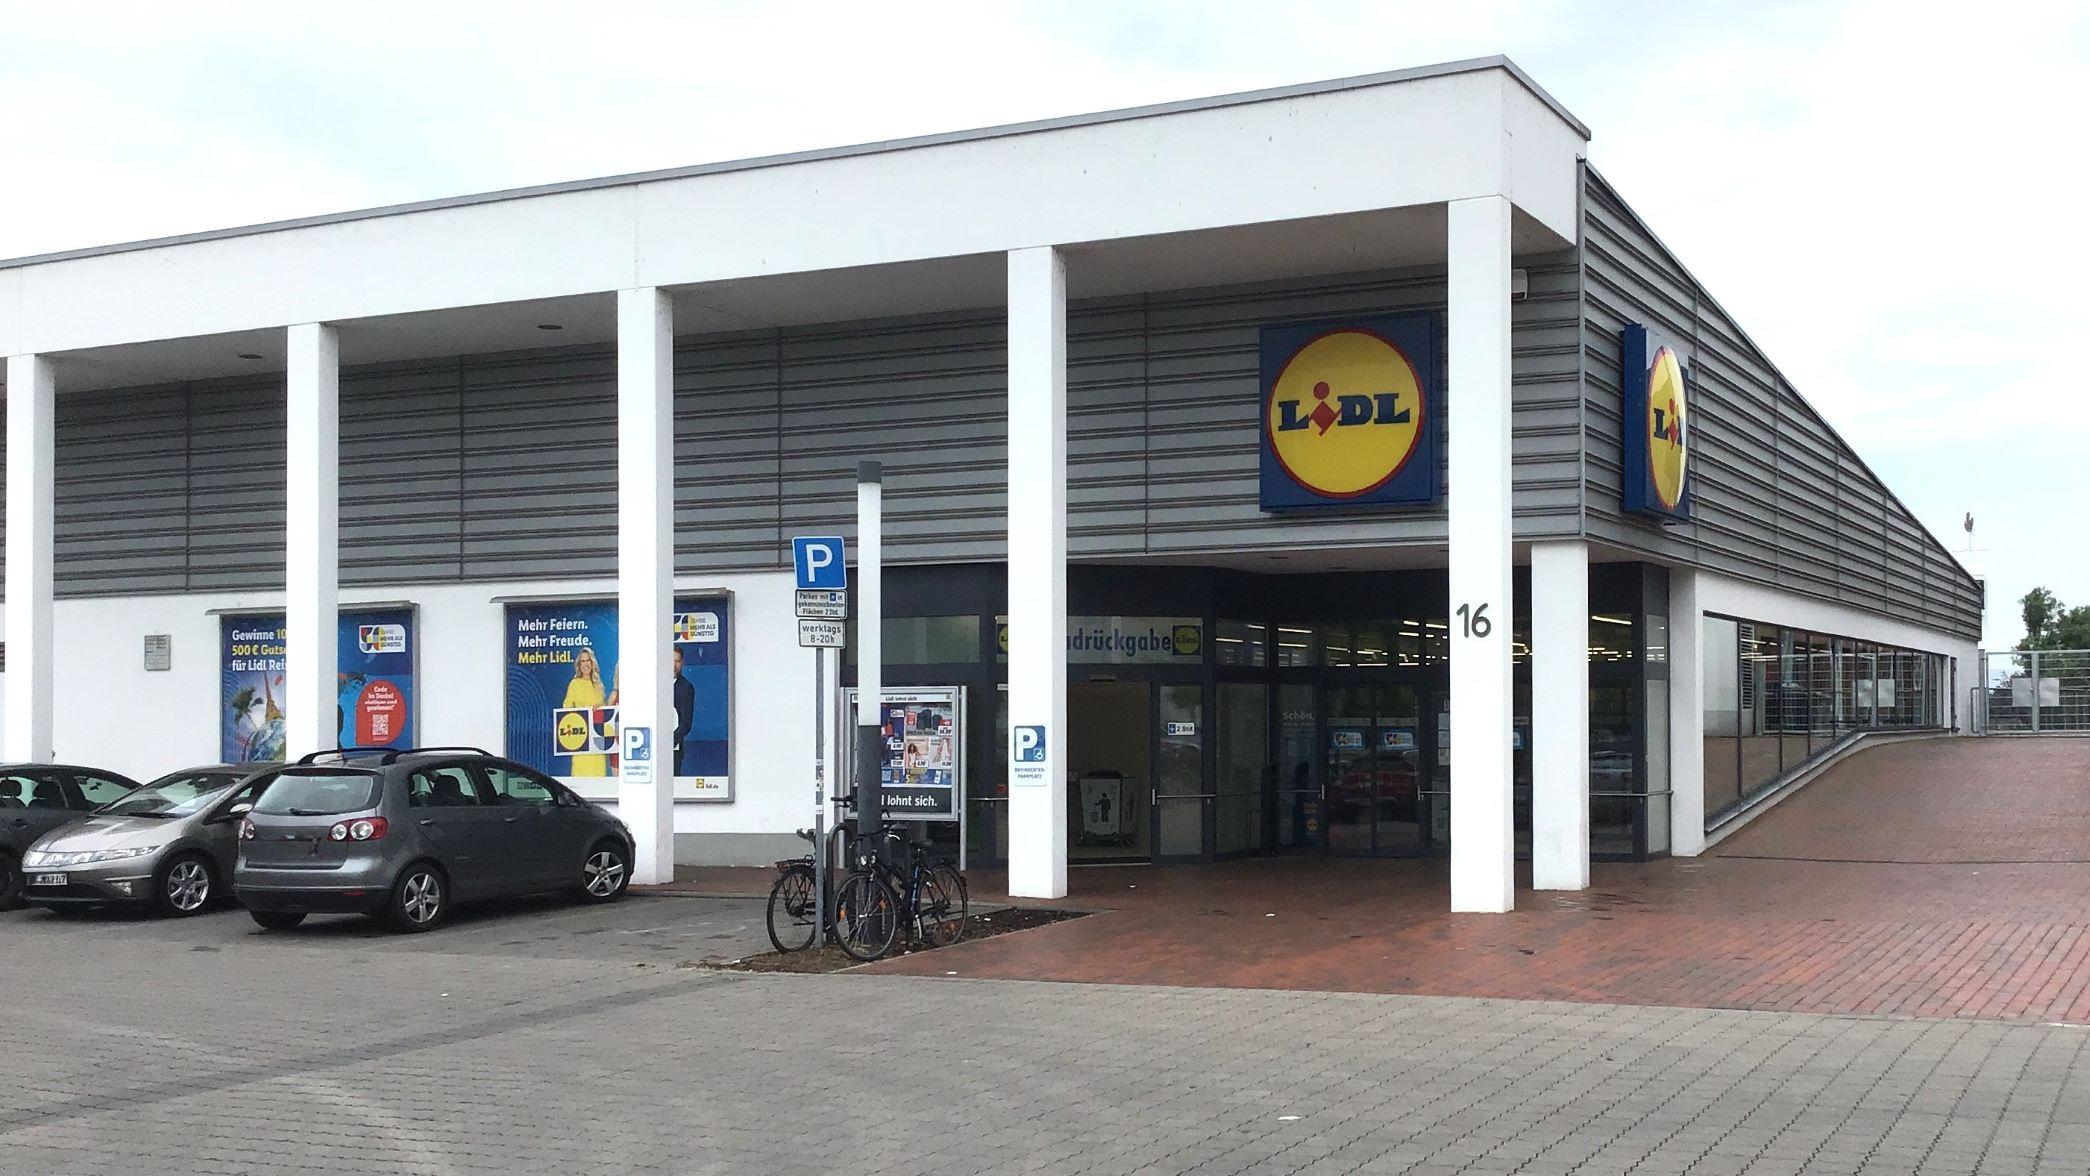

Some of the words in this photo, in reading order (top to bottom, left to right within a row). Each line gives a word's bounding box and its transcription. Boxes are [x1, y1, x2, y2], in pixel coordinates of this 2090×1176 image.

[806, 544, 833, 582] P
[799, 592, 818, 600] Parken
[518, 619, 547, 631] Mehr
[549, 618, 588, 630] Feiern.
[1456, 603, 1491, 638] 16
[232, 629, 274, 640] Gewinne
[518, 635, 547, 648] Mehr
[549, 634, 592, 646] Freude.
[232, 645, 251, 656] 500
[518, 652, 547, 664] Mehr
[549, 651, 574, 663] Lidl.
[232, 660, 246, 671] für
[248, 659, 267, 671] Lidl
[888, 795, 914, 806] lohnt
[915, 795, 938, 806] sich.
